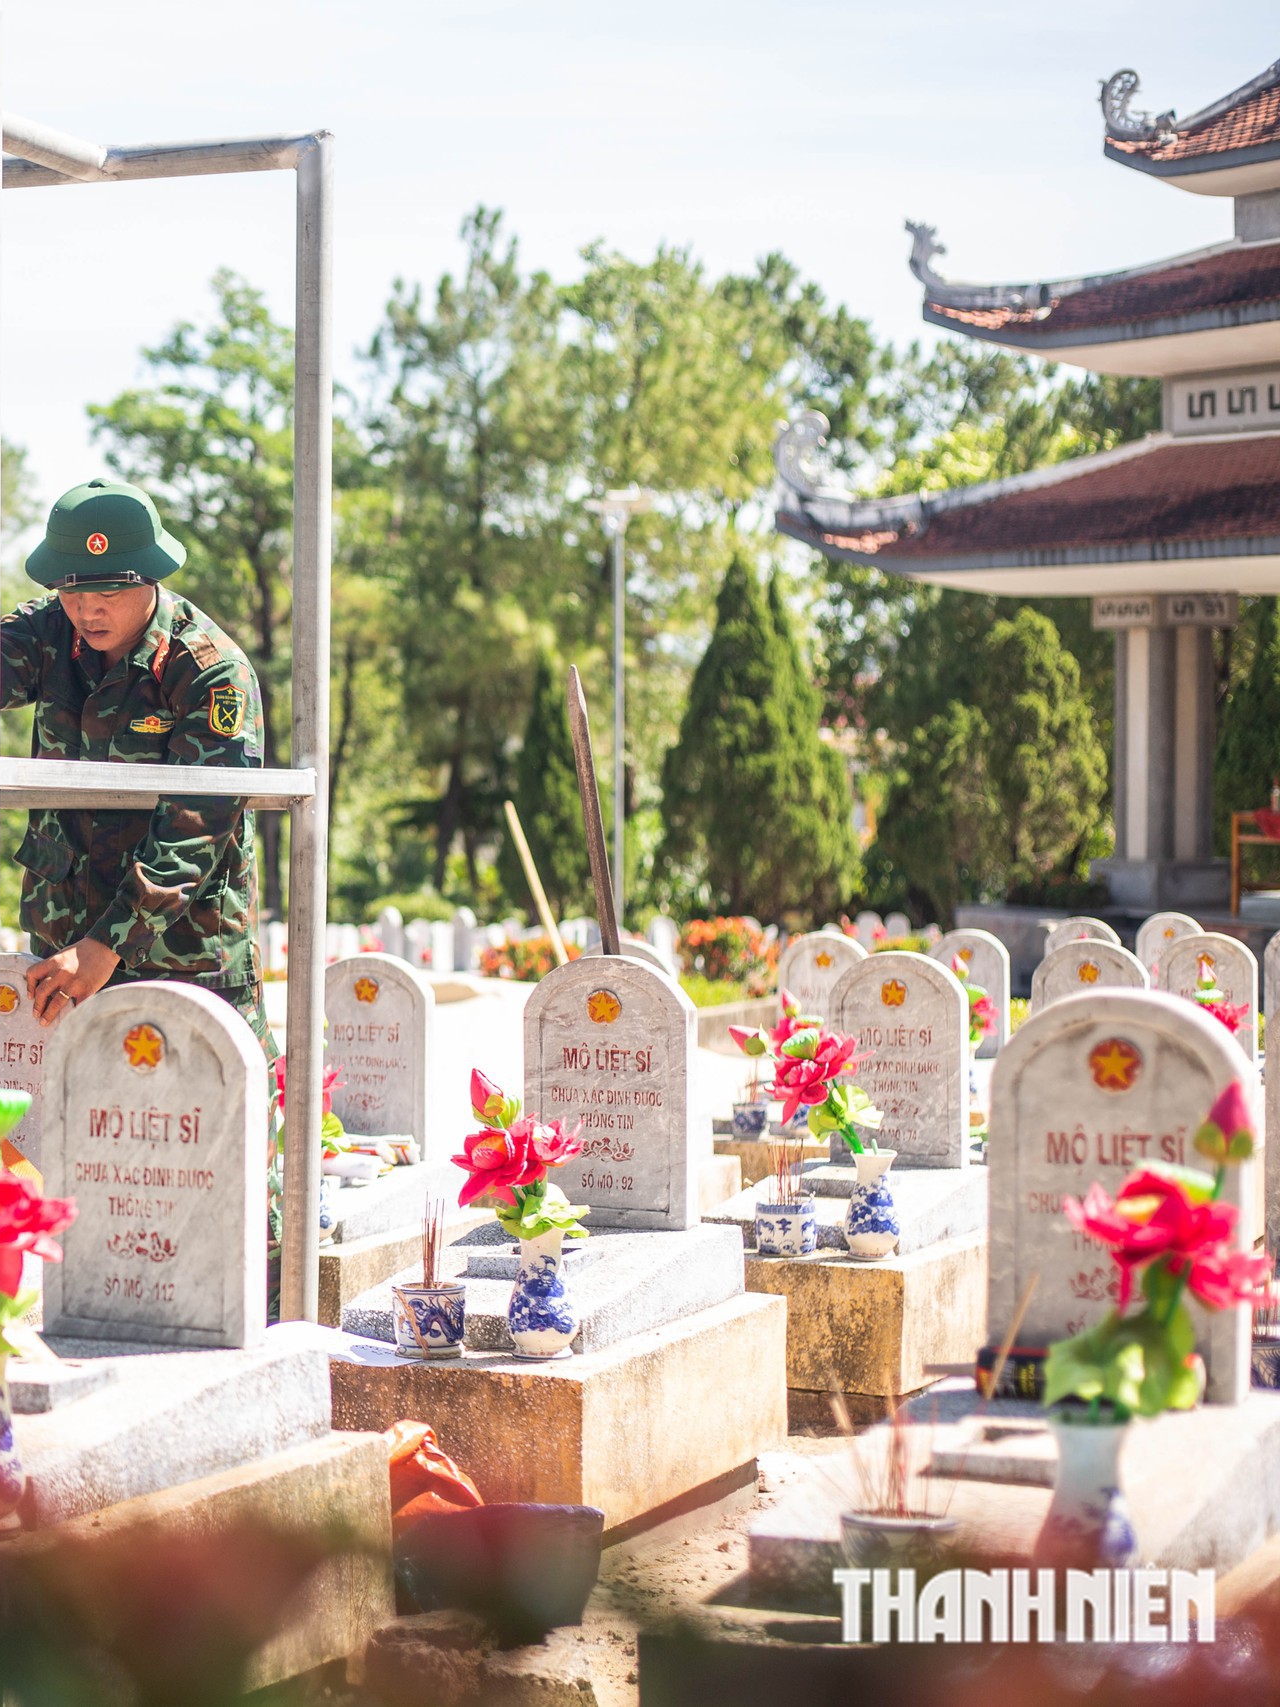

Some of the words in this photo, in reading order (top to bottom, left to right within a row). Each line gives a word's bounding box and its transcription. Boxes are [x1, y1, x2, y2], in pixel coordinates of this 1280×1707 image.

[595, 1044, 631, 1077] LIỆT
[635, 1045, 653, 1073] SĨ
[90, 1104, 124, 1146] MỘ
[130, 1106, 172, 1150] LIỆT
[179, 1107, 202, 1144] SĨ
[579, 1109, 614, 1129] THÔNG
[616, 1114, 634, 1130] TIN
[621, 1175, 633, 1190] 92
